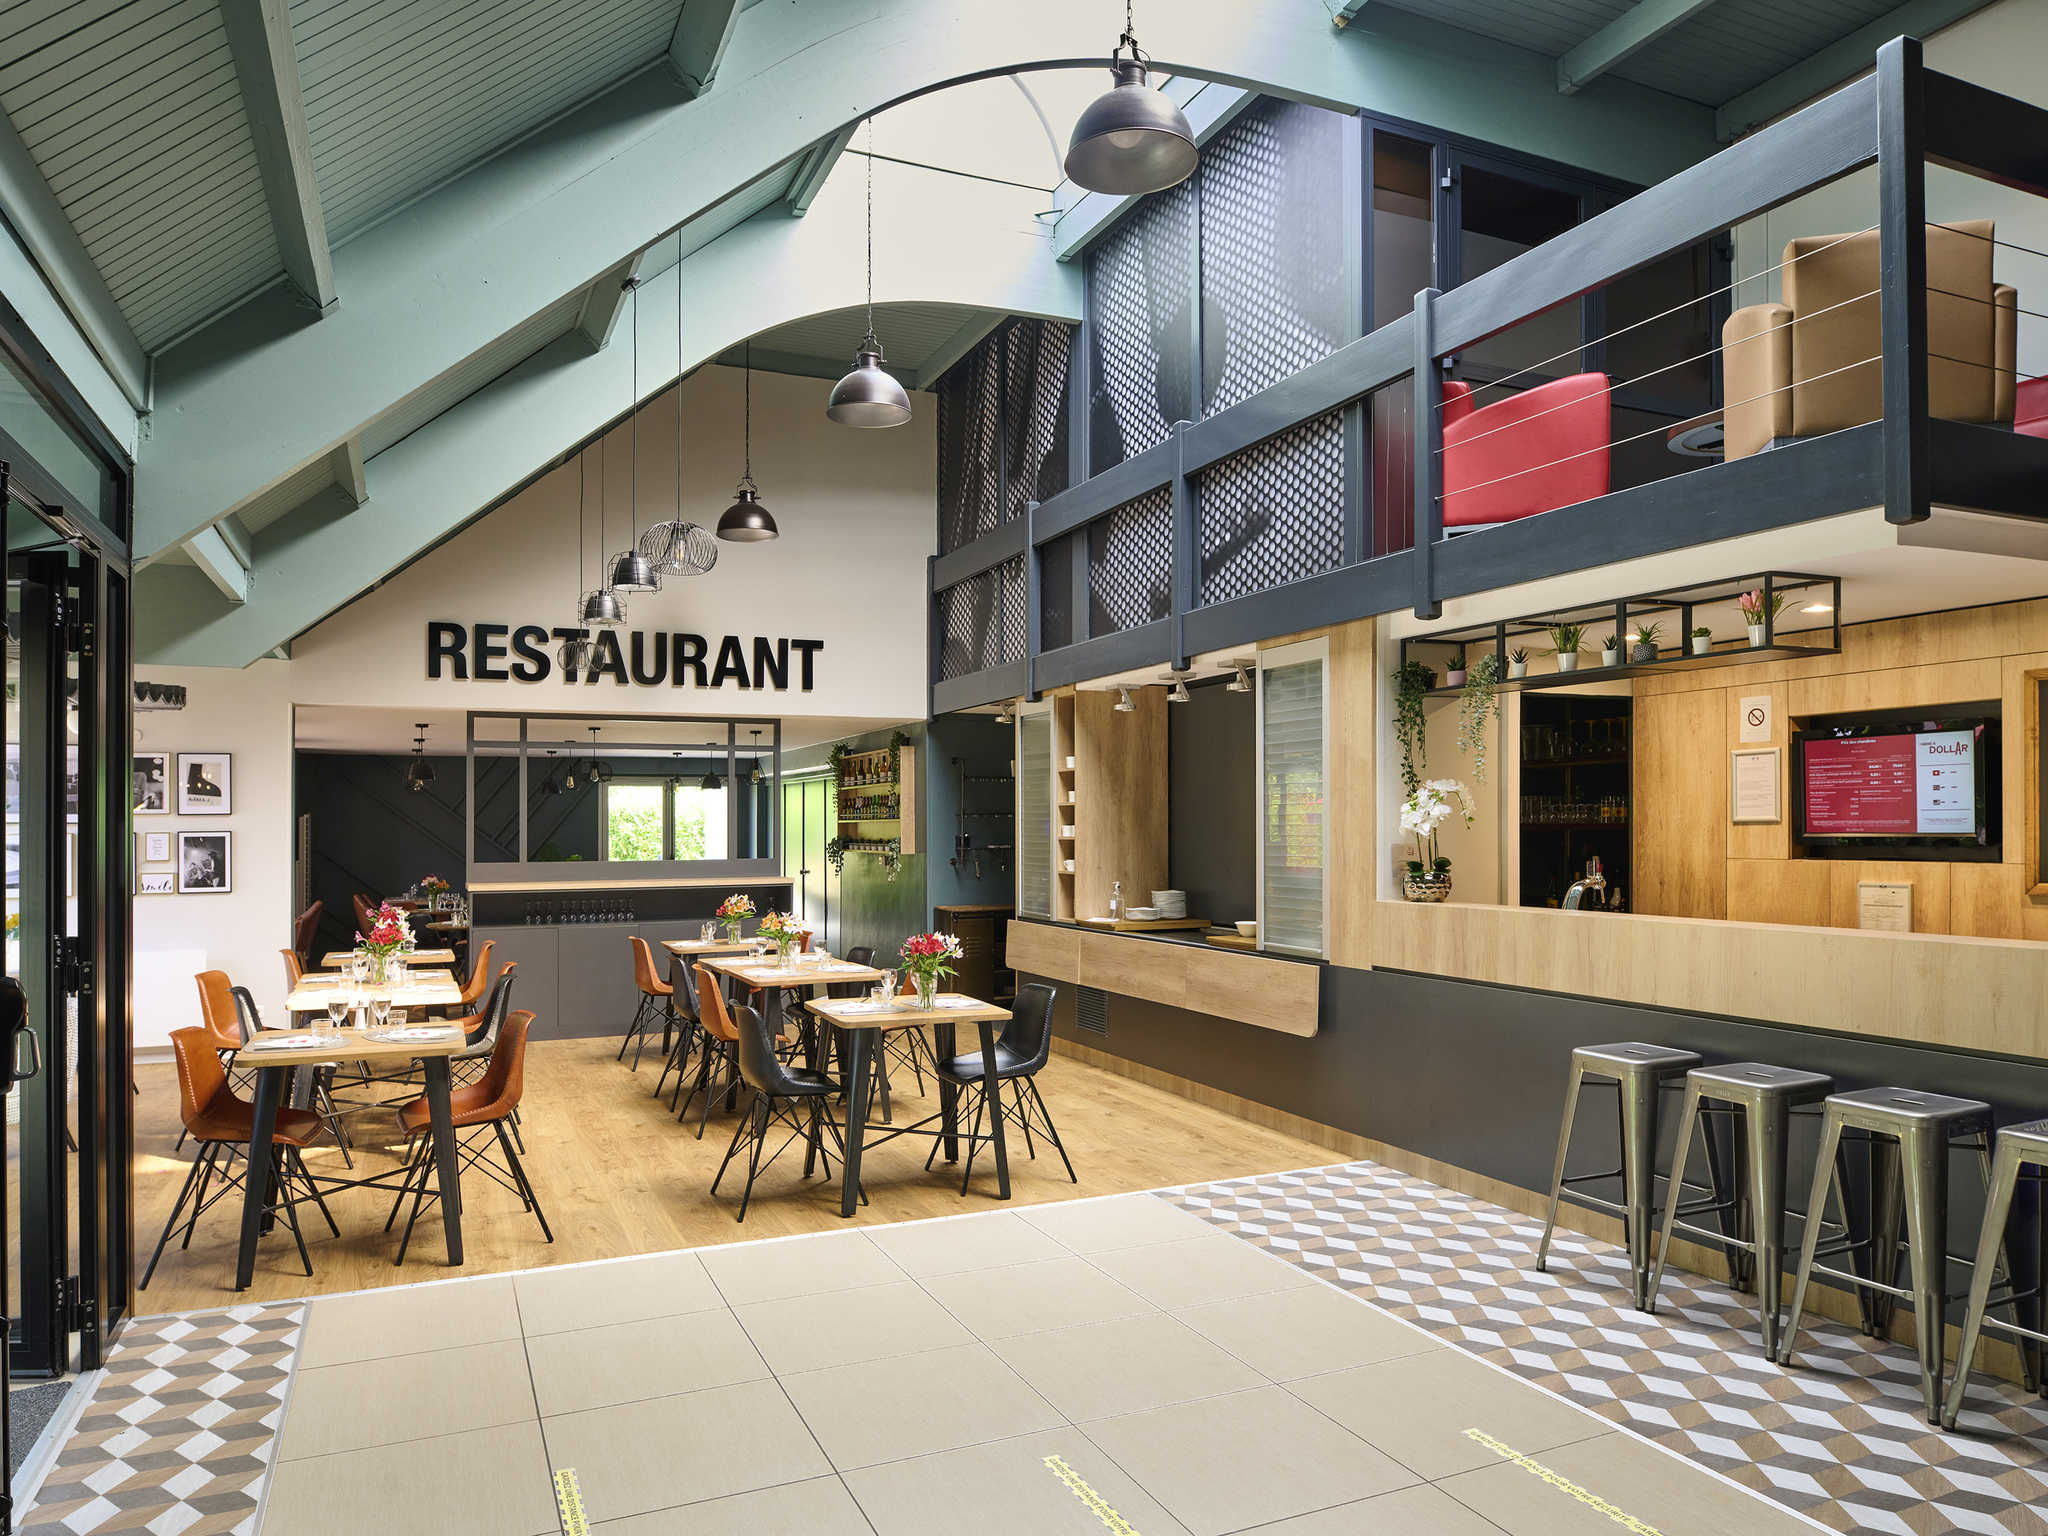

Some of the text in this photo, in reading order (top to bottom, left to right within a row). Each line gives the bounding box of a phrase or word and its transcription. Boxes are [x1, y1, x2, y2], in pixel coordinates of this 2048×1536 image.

[426, 621, 825, 691] RESTAURANT
[1929, 741, 1968, 755] DOLLAR
[1048, 1458, 1130, 1536] GARDEZ UNE DISTANCE POUR VOTRE
[1567, 1484, 1592, 1501] VOTRE
